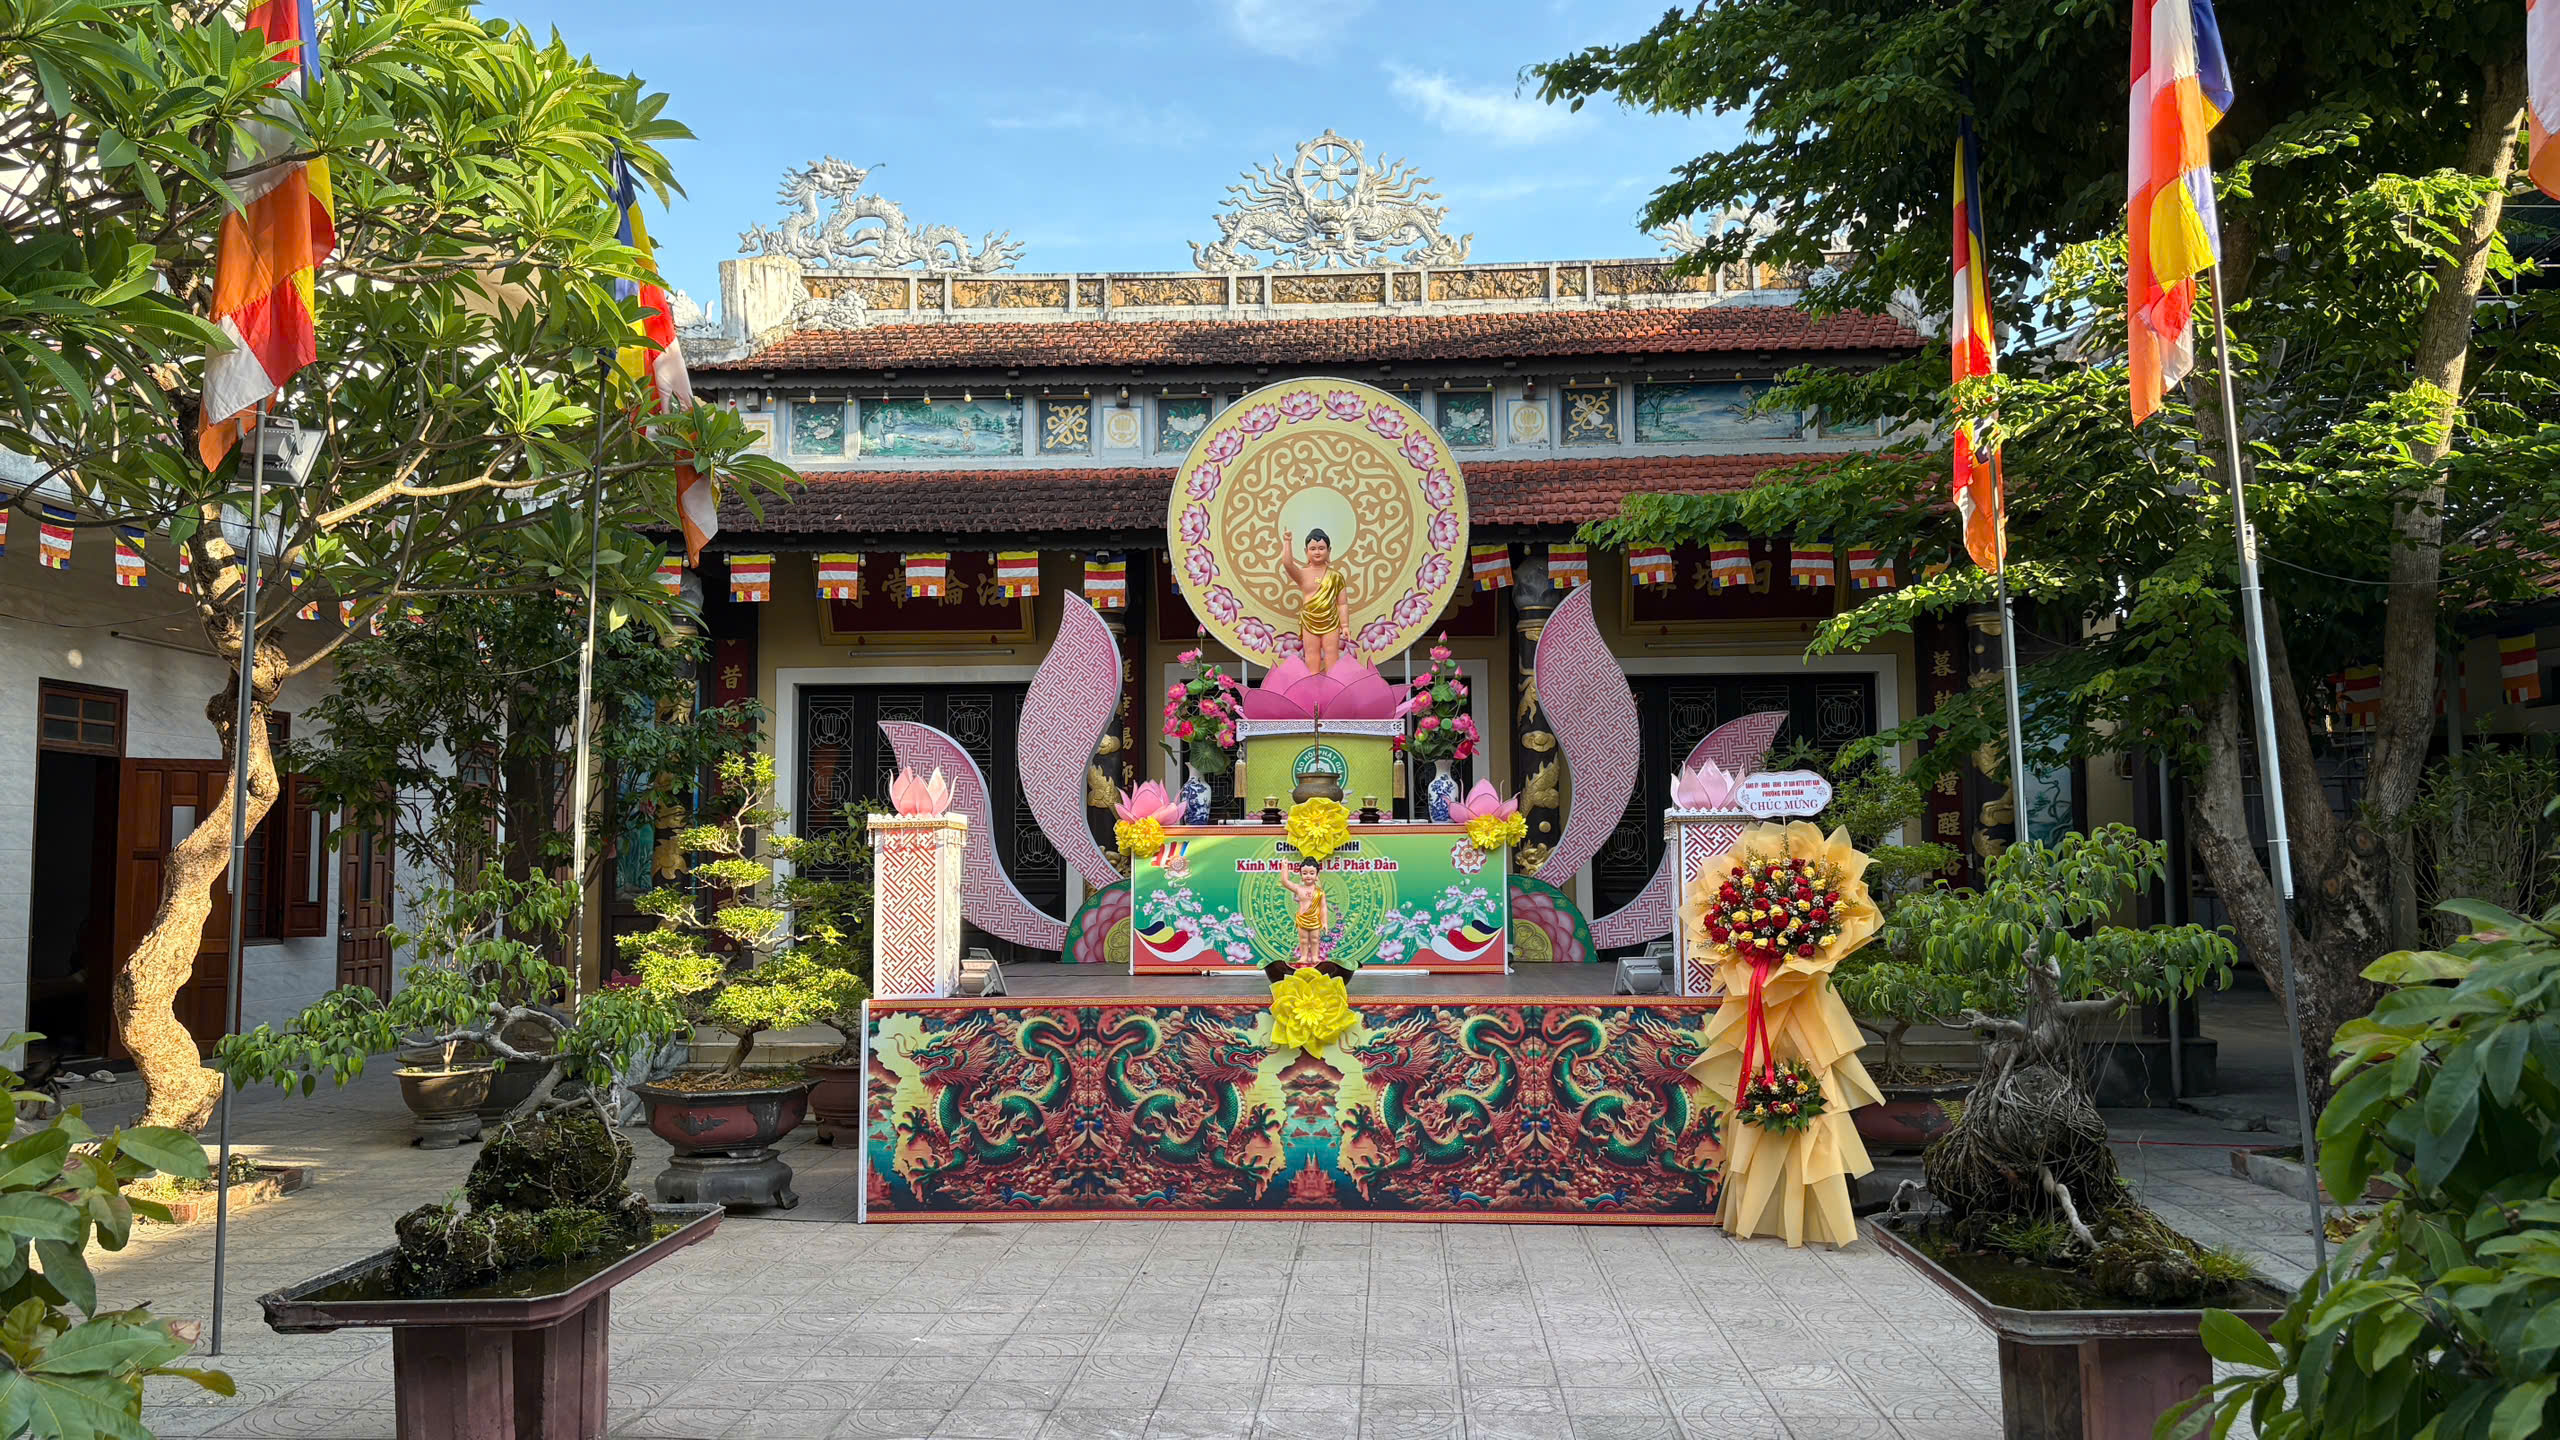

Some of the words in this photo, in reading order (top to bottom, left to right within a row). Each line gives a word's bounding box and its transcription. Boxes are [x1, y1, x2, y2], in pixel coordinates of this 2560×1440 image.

[1750, 799, 1781, 811] CHÚC
[1784, 797, 1818, 809] MỪNG
[1236, 858, 1265, 871] Kính
[1326, 857, 1341, 870] Lễ
[1343, 858, 1371, 873] Phật
[1373, 857, 1397, 870] Đản
